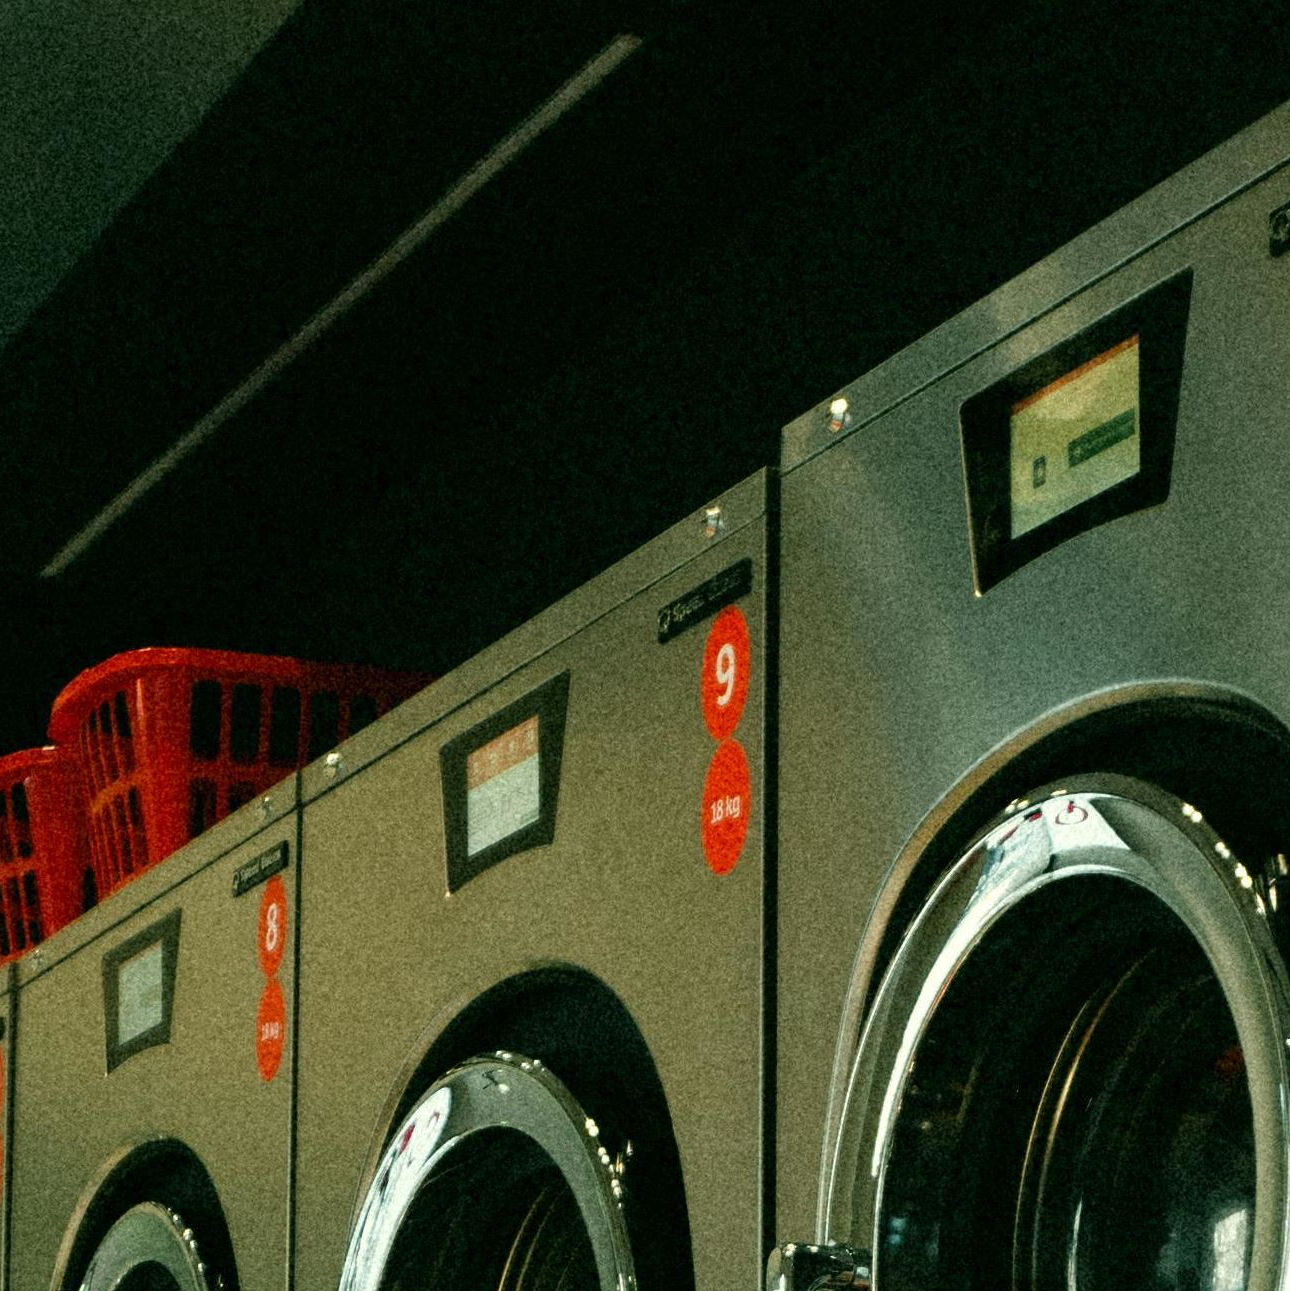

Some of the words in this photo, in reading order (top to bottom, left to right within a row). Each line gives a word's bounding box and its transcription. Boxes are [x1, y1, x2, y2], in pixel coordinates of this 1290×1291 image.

[715, 643, 736, 707] 9
[710, 799, 725, 825] 18
[725, 795, 740, 819] kg
[265, 902, 279, 952] 8
